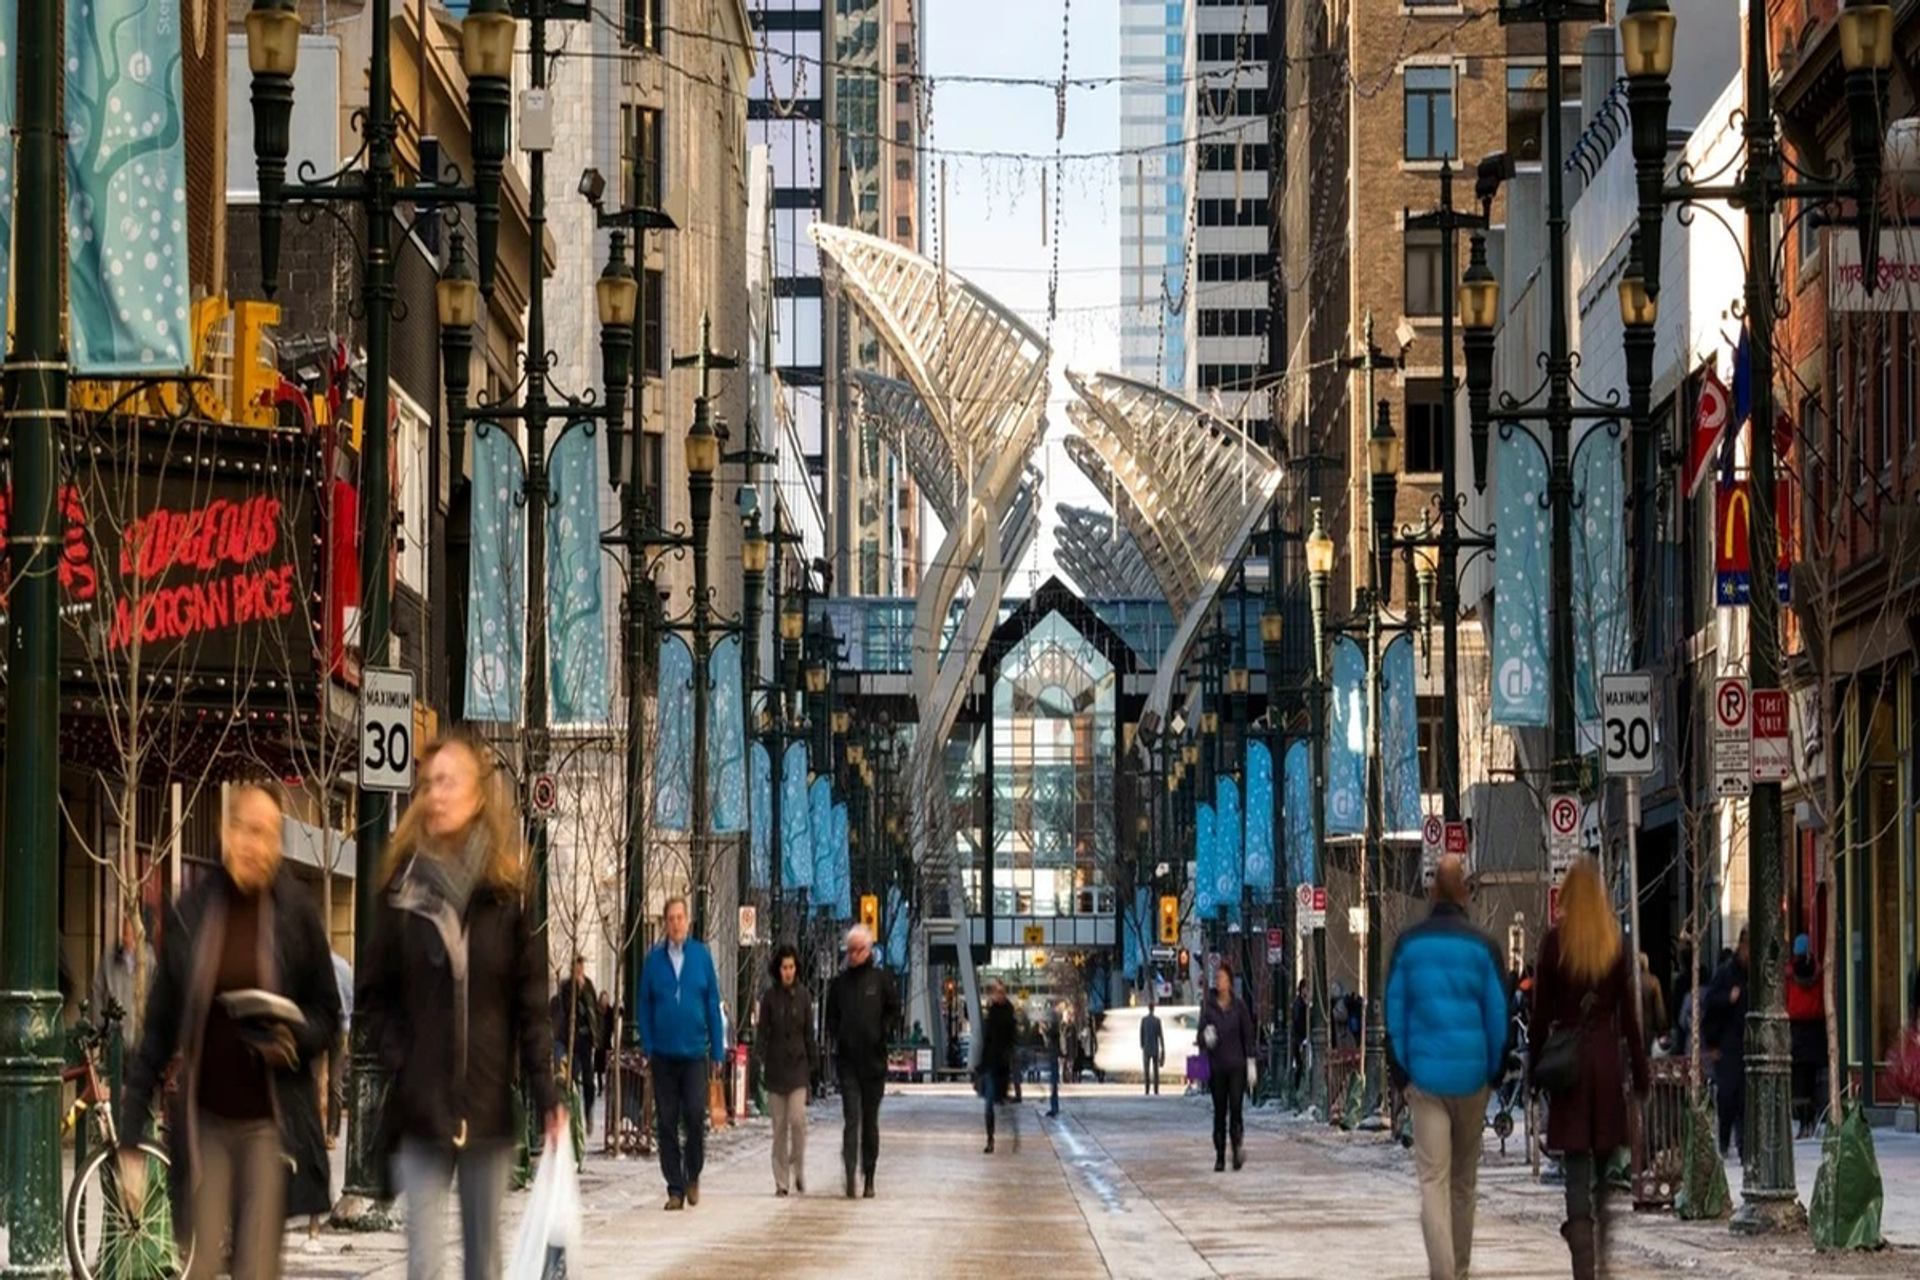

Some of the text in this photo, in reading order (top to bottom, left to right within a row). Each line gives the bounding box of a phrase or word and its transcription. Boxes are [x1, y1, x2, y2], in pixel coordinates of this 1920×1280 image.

[366, 689, 410, 710] MAXIMUM
[1606, 691, 1650, 706] MAXIMUM
[364, 720, 409, 774] 30
[1606, 717, 1651, 760] 30
